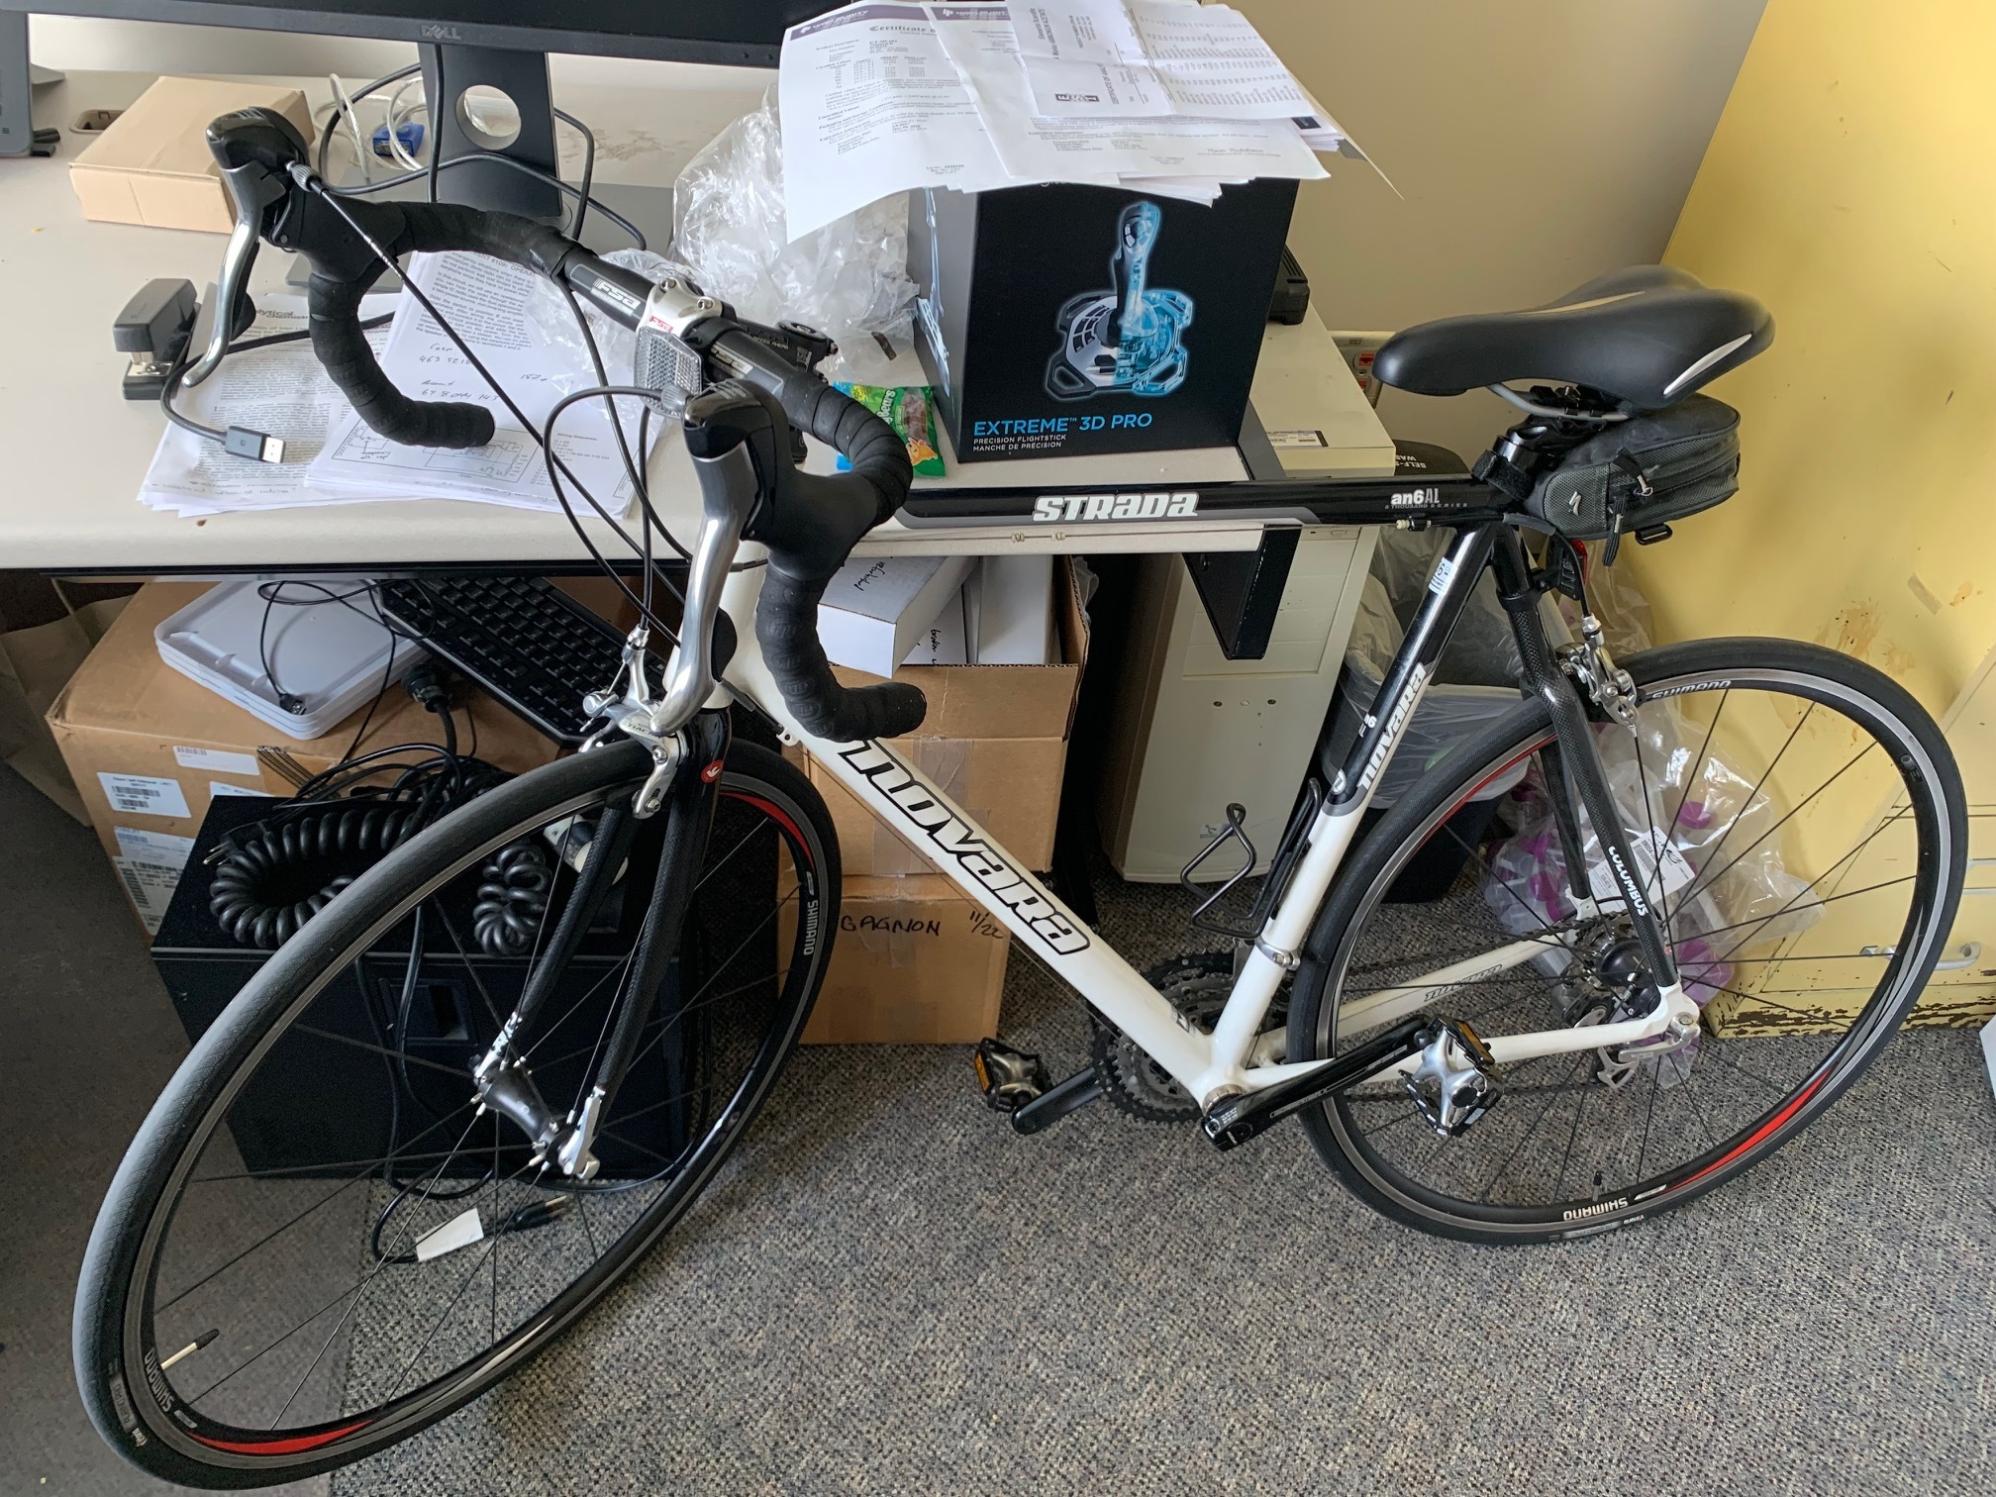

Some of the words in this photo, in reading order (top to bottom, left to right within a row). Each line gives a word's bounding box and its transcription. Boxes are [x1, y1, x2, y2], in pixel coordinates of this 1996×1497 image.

[421, 25, 461, 39] DELL
[1079, 416, 1105, 431] 3D
[1111, 413, 1152, 429] PRO
[973, 436, 1015, 445] PRECISION
[1017, 434, 1067, 443] FLIGHTSTICK
[973, 444, 1007, 452] MANCHE
[1608, 845, 1649, 916] COLUMBUS
[804, 899, 819, 956] SHIMANO
[1563, 1197, 1628, 1221] SHIMANO
[144, 1347, 175, 1412] SHIMANO
